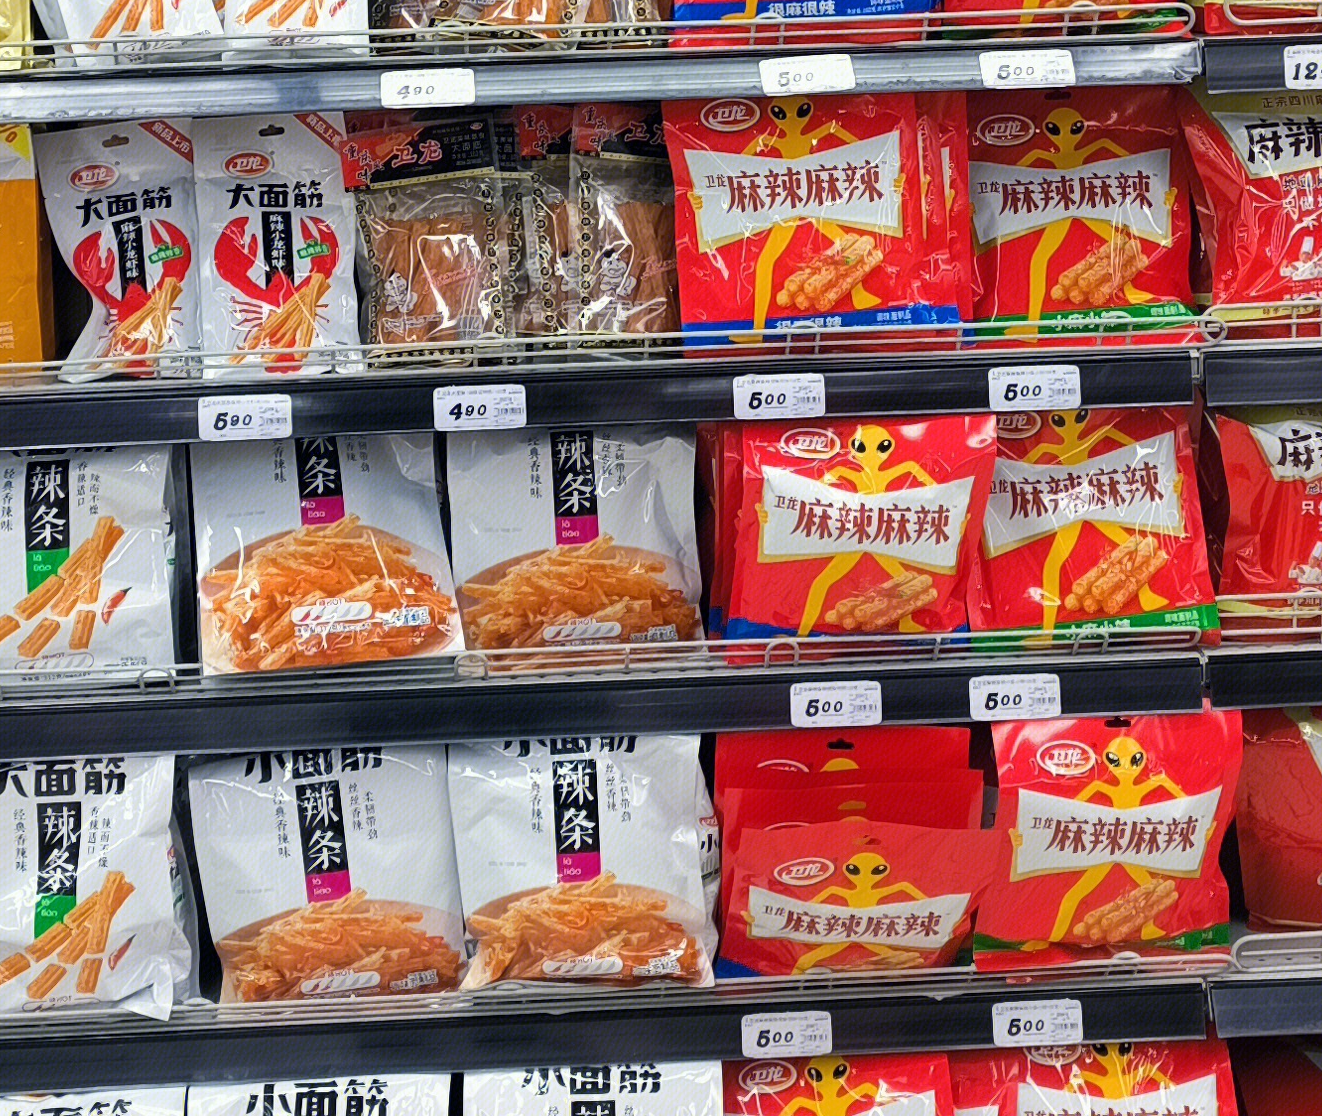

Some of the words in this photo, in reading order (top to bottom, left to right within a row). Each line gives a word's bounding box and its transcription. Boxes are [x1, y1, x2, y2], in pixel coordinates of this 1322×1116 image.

[726, 160, 882, 216] 麻辣麻辣
[998, 169, 1151, 216] 麻辣麻辣
[29, 464, 66, 548] 辣条
[790, 499, 952, 546] 麻辣麻辣
[301, 788, 344, 869] 辣条
[556, 766, 596, 851] 辣条
[1045, 813, 1200, 854] 麻辣麻辣
[782, 908, 942, 940] 麻辣麻辣
